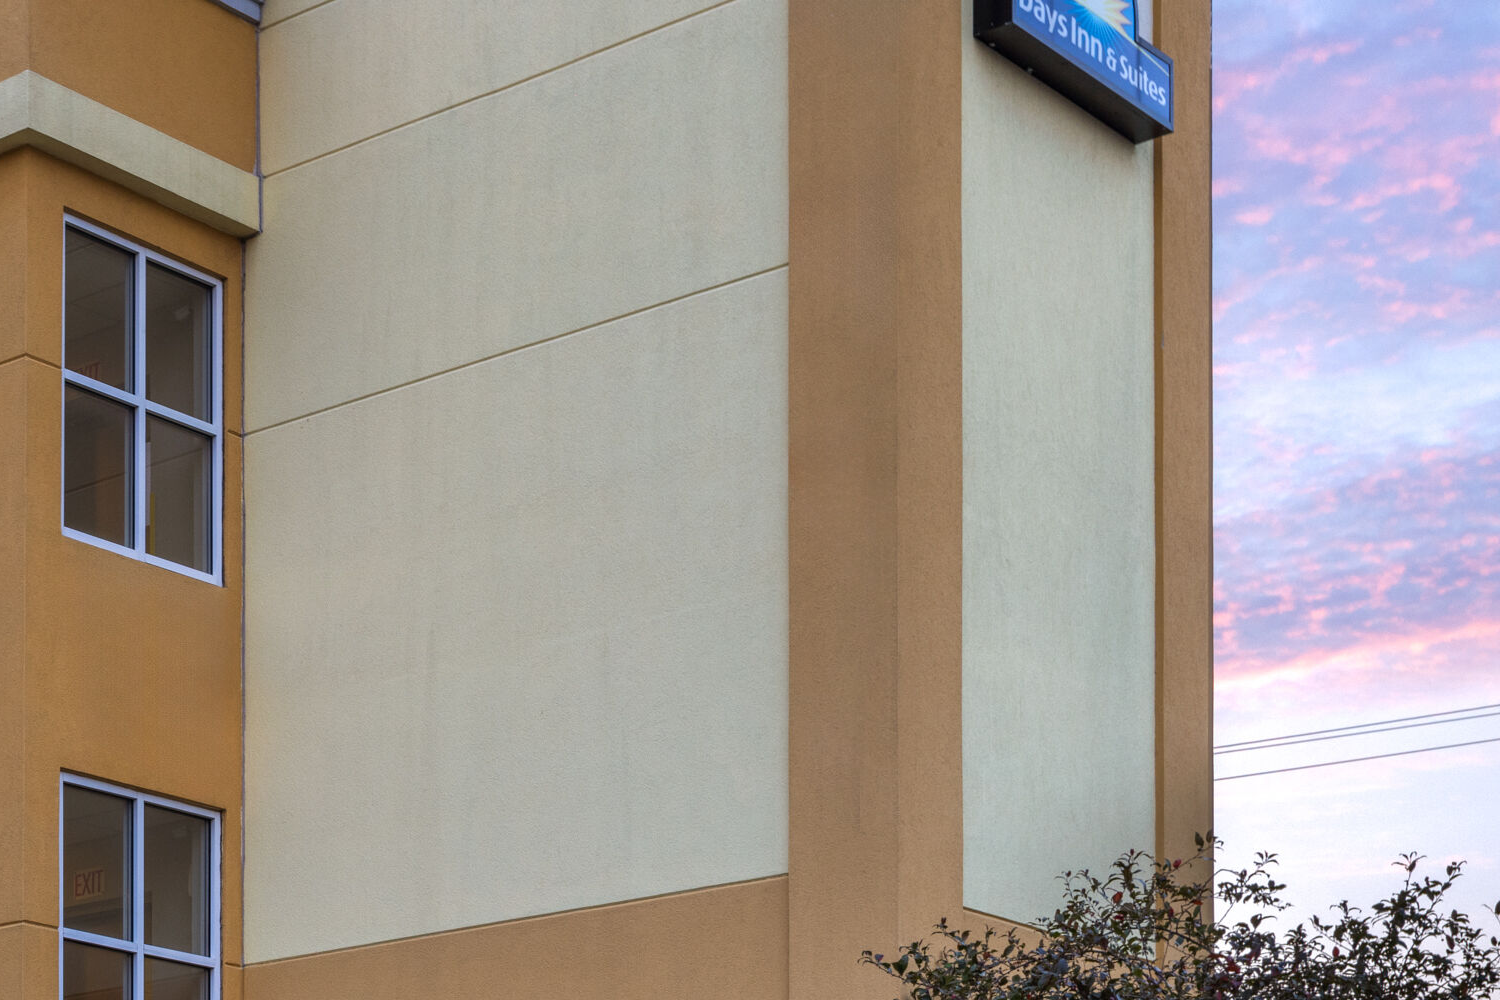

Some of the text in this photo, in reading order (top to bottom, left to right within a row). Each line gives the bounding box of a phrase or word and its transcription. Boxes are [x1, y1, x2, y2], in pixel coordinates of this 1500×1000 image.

[1071, 16, 1103, 63] Inn
[1105, 47, 1117, 72] &
[1120, 55, 1167, 106] Suites
[75, 870, 103, 897] EXIT
